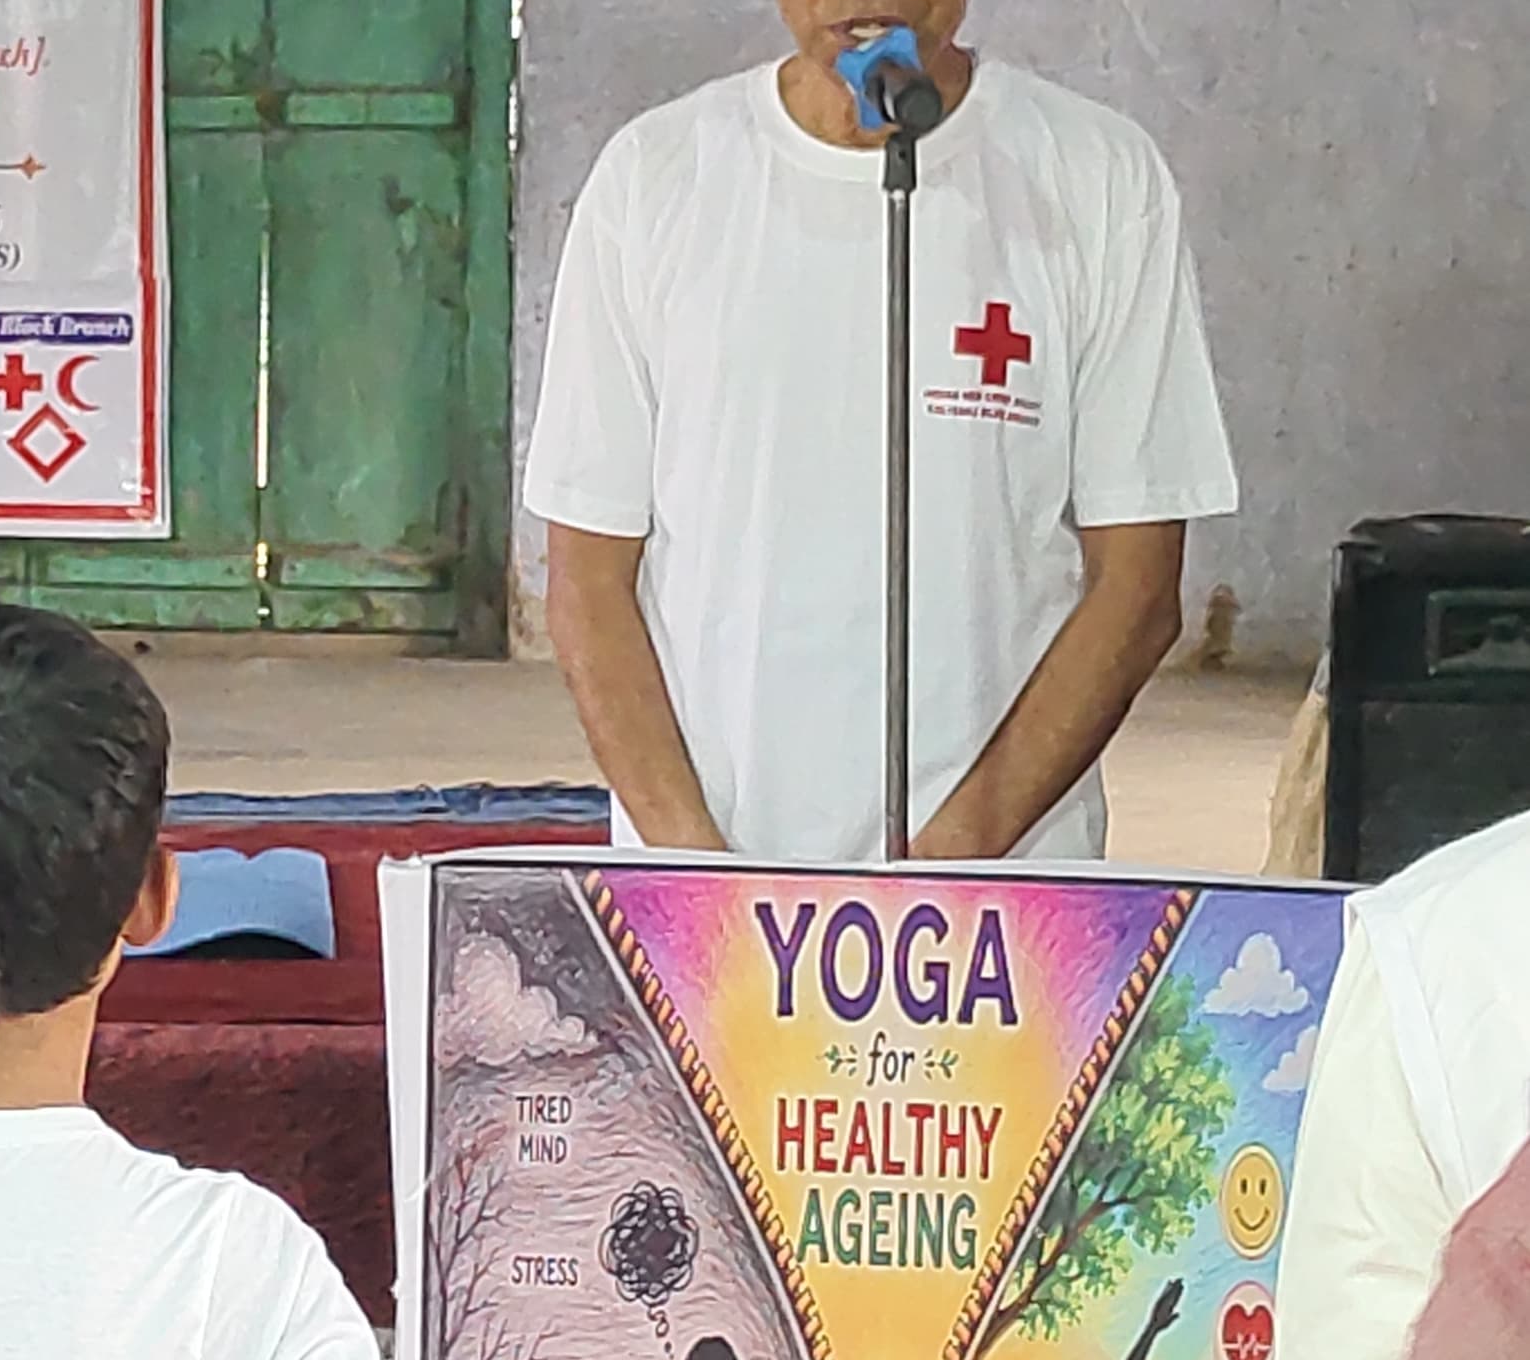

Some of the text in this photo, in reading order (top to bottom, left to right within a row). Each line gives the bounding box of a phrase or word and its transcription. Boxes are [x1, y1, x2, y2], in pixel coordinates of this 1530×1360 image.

[755, 900, 1019, 1026] YOGA
[866, 1031, 915, 1086] for
[516, 1095, 572, 1125] TIRED
[518, 1138, 568, 1164] MIND
[776, 1097, 1003, 1180] HEALTHY
[795, 1187, 978, 1270] AGEING
[510, 1256, 579, 1286] STRESS
